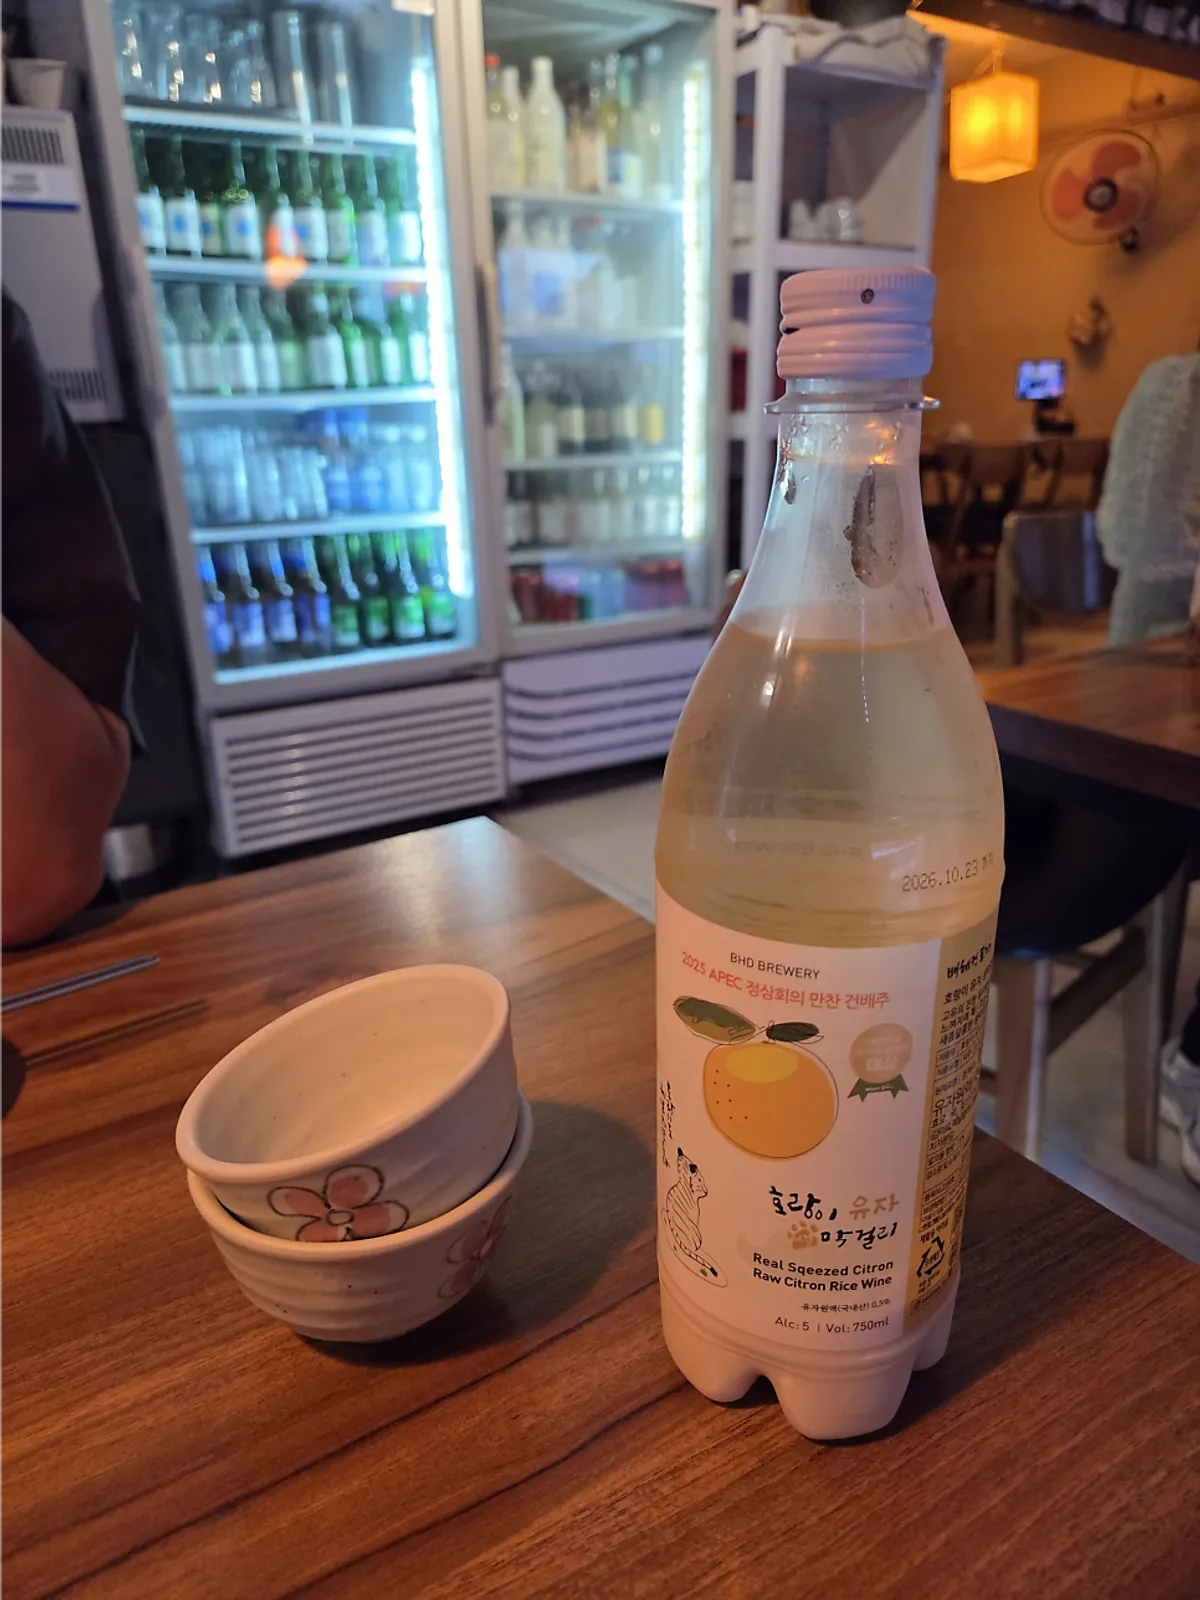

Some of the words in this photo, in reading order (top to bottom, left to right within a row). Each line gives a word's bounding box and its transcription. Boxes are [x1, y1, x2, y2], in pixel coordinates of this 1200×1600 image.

[901, 859, 979, 892] 2026.10.23
[730, 952, 755, 968] BHD
[757, 960, 821, 980] BREWERY
[682, 951, 706, 975] 2025
[708, 968, 743, 990] APEC
[746, 980, 805, 1007] 정상회의
[809, 992, 843, 1010] 만찬
[844, 992, 890, 1010] 건배주
[769, 1185, 838, 1220] 호랑이
[849, 1192, 899, 1220] 유자
[820, 1221, 898, 1250] 막걸리
[753, 1252, 784, 1270] Real
[788, 1262, 849, 1277] Sqeezed
[853, 1261, 894, 1276] Citron
[753, 1267, 782, 1285] Raw
[784, 1276, 826, 1292] Citron
[829, 1281, 858, 1292] Rice
[861, 1276, 892, 1290] Wine
[853, 1316, 889, 1333] 750ml
